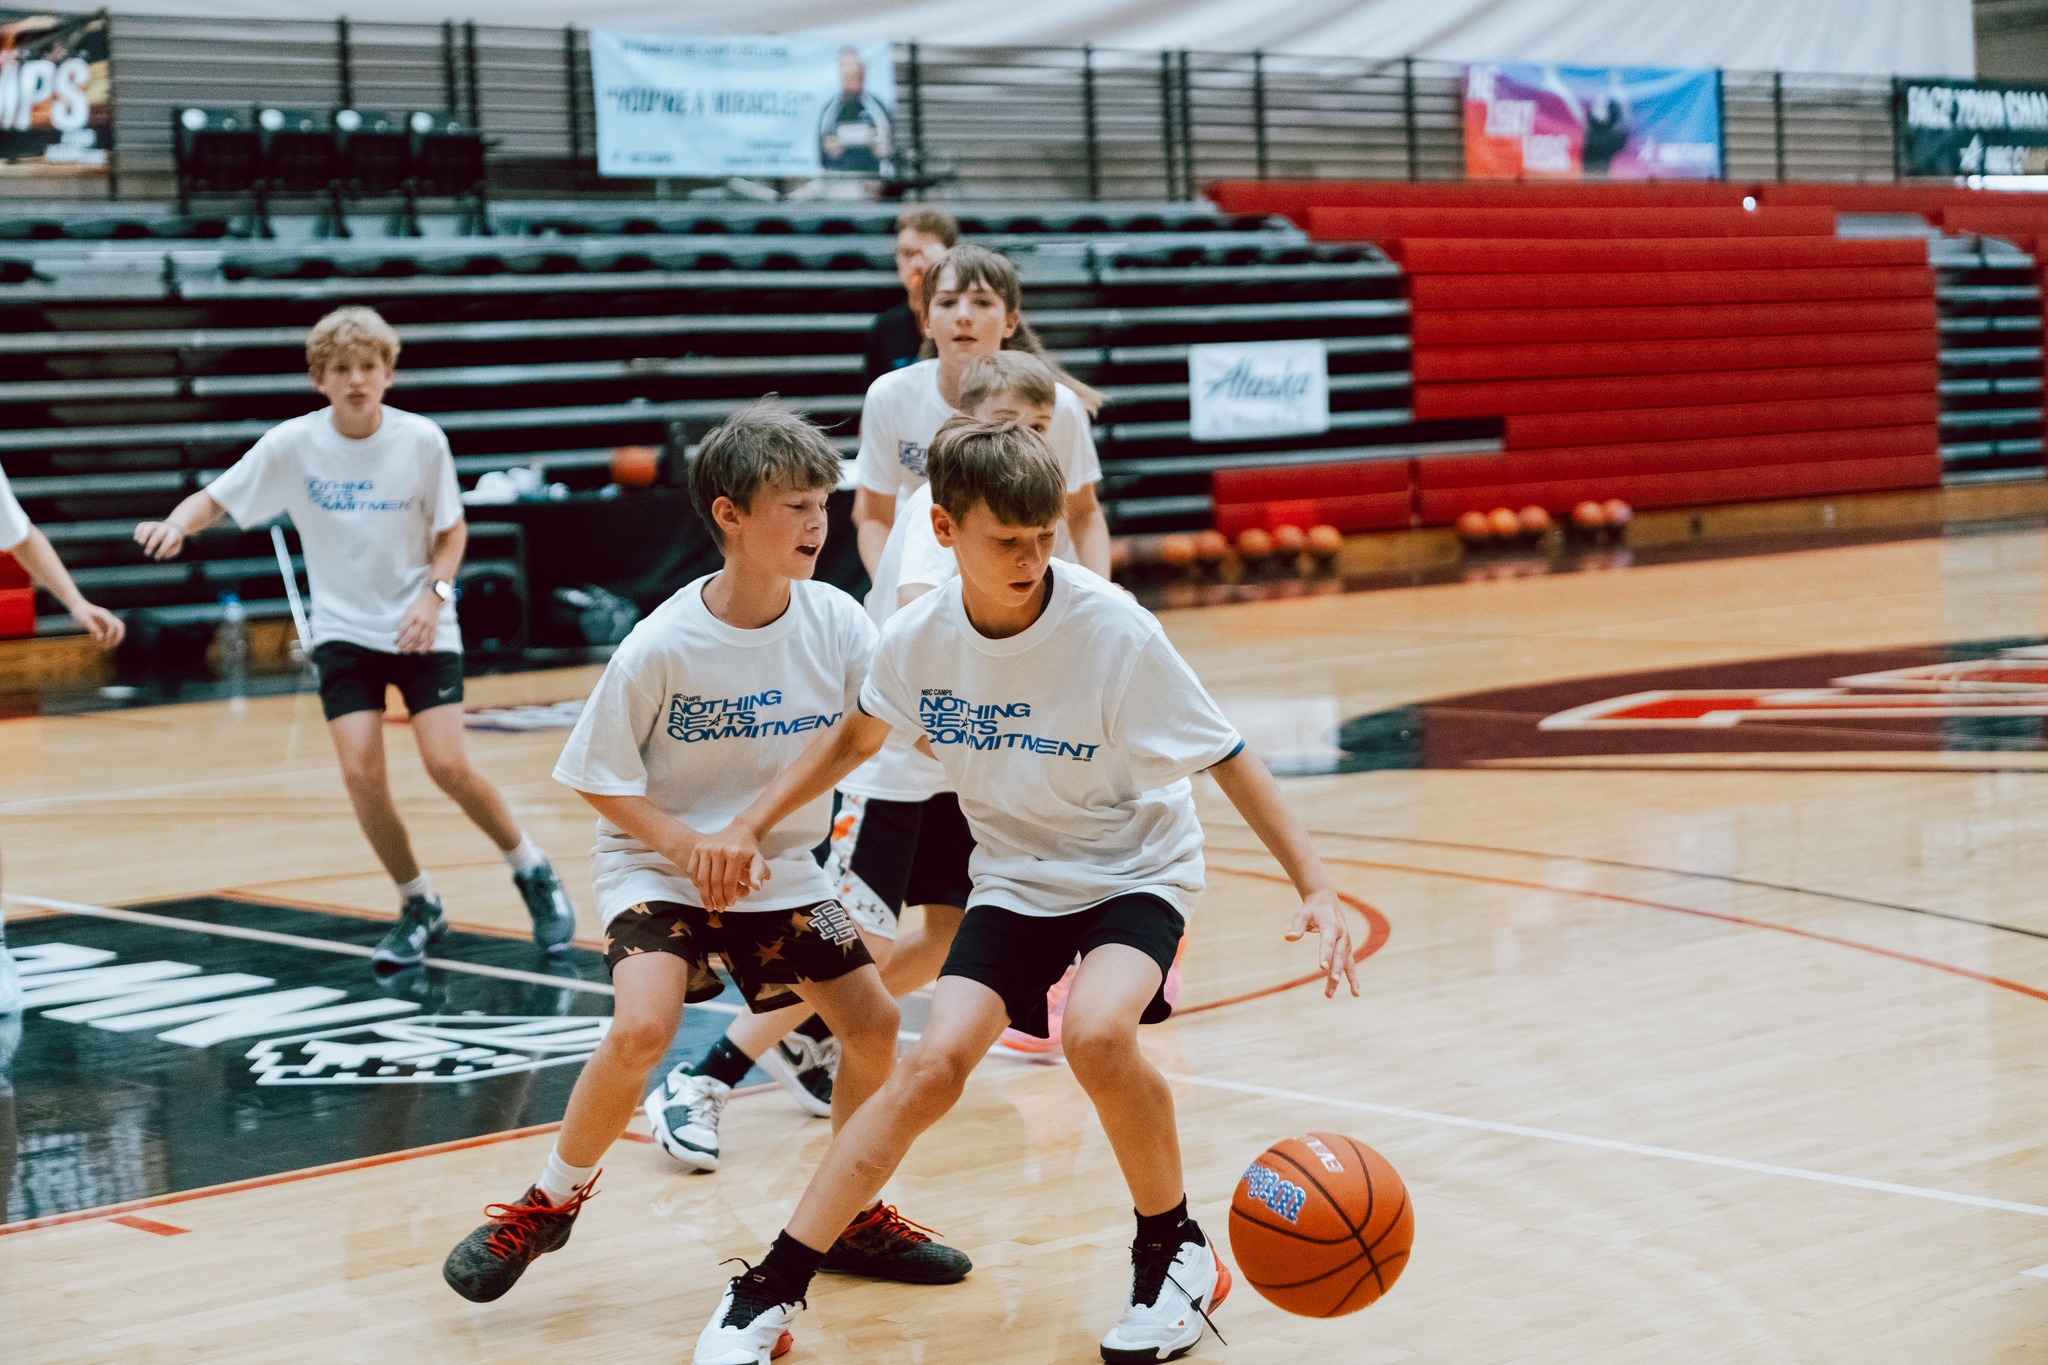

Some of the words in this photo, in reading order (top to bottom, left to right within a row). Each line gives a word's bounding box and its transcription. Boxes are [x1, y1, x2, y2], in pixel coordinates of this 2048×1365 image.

[670, 689, 783, 715] NOTHING
[934, 689, 953, 697] CAMPS
[919, 696, 1032, 720] NOTHING
[668, 711, 756, 729] BEATS
[919, 712, 998, 735] BEATS
